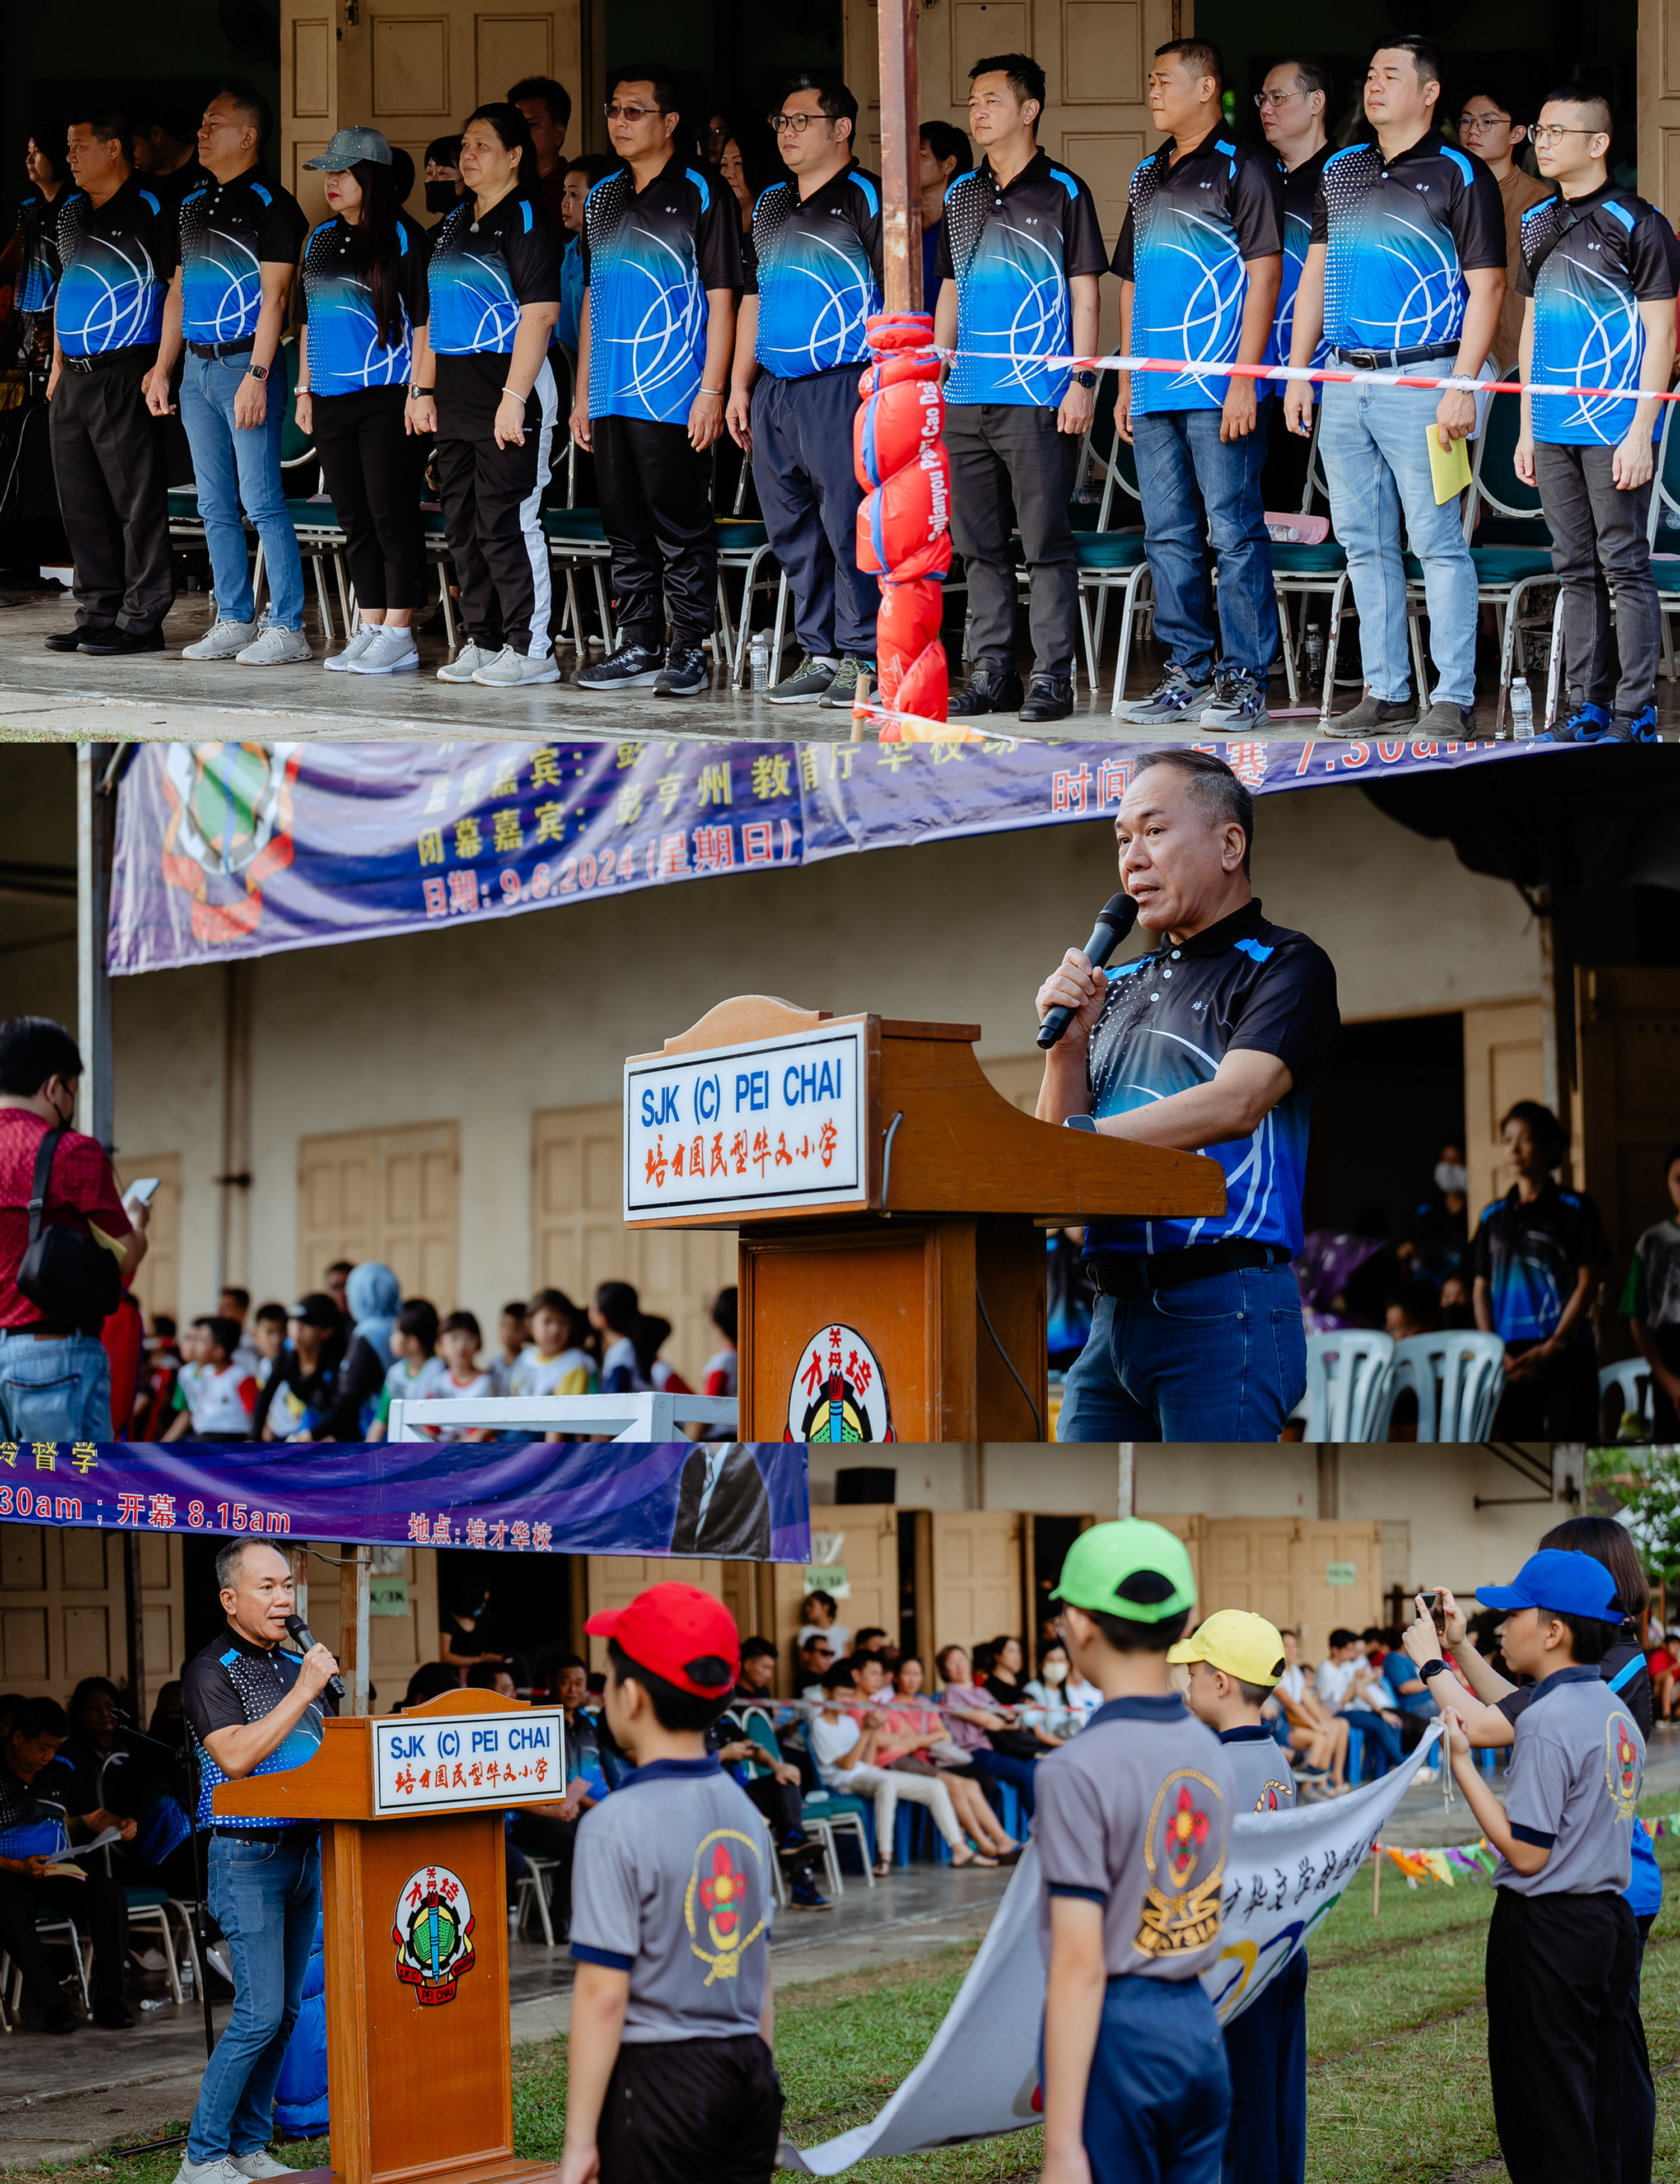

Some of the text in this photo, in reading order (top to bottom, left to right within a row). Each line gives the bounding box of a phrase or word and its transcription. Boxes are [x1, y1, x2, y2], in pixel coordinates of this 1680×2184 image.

[916, 381, 940, 405] Dai
[921, 407, 940, 437] Cao
[641, 1058, 841, 1127] SJK (C) PEI CHAI
[645, 1118, 837, 1188] 培才国民型华文小学
[117, 1492, 176, 1529] 开幕
[187, 1500, 291, 1533] 8.15am
[390, 1726, 550, 1760] SJK (C) PEI CHAI
[399, 1969, 409, 1979] SJK
[422, 1986, 454, 2001] PEI CHAI
